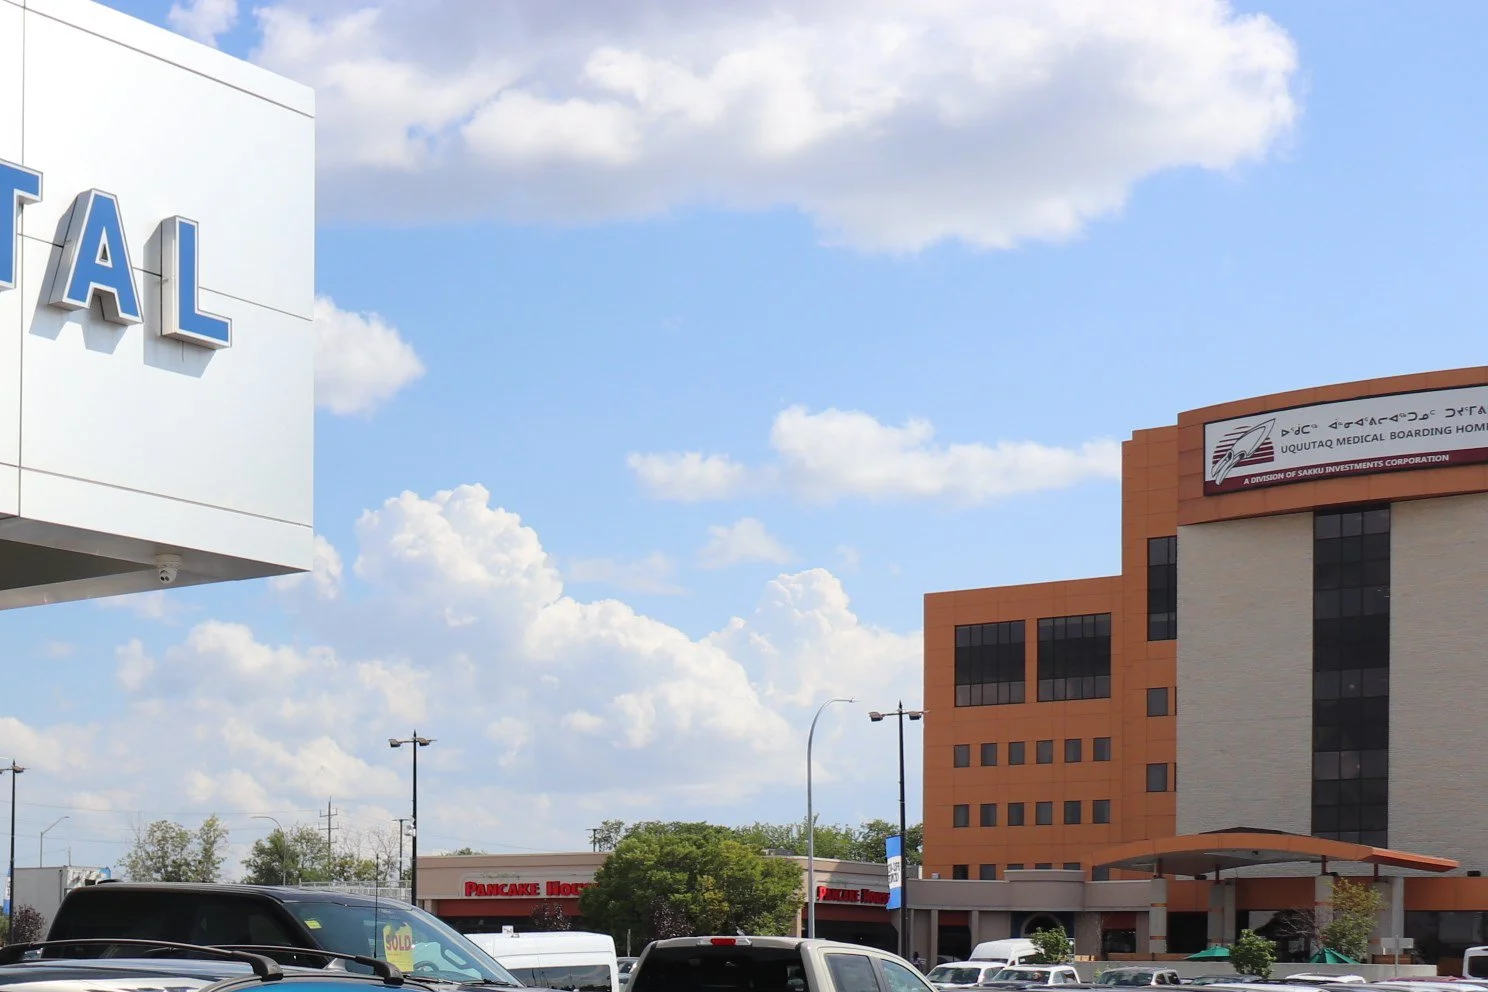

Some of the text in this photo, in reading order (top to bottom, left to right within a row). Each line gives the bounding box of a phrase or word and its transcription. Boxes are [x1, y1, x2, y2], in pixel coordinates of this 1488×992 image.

[1281, 439, 1334, 454] UQUUTAQ
[1336, 433, 1385, 446] MEDICAL
[1390, 426, 1452, 440] BOARDING
[1251, 472, 1284, 484] DIVISION
[1297, 467, 1324, 477] SAKKU
[1325, 460, 1383, 473] INVESTMENTS
[1385, 454, 1450, 466] CORPORATION
[465, 881, 540, 897] PANCAKE
[386, 934, 412, 951] SOLD
